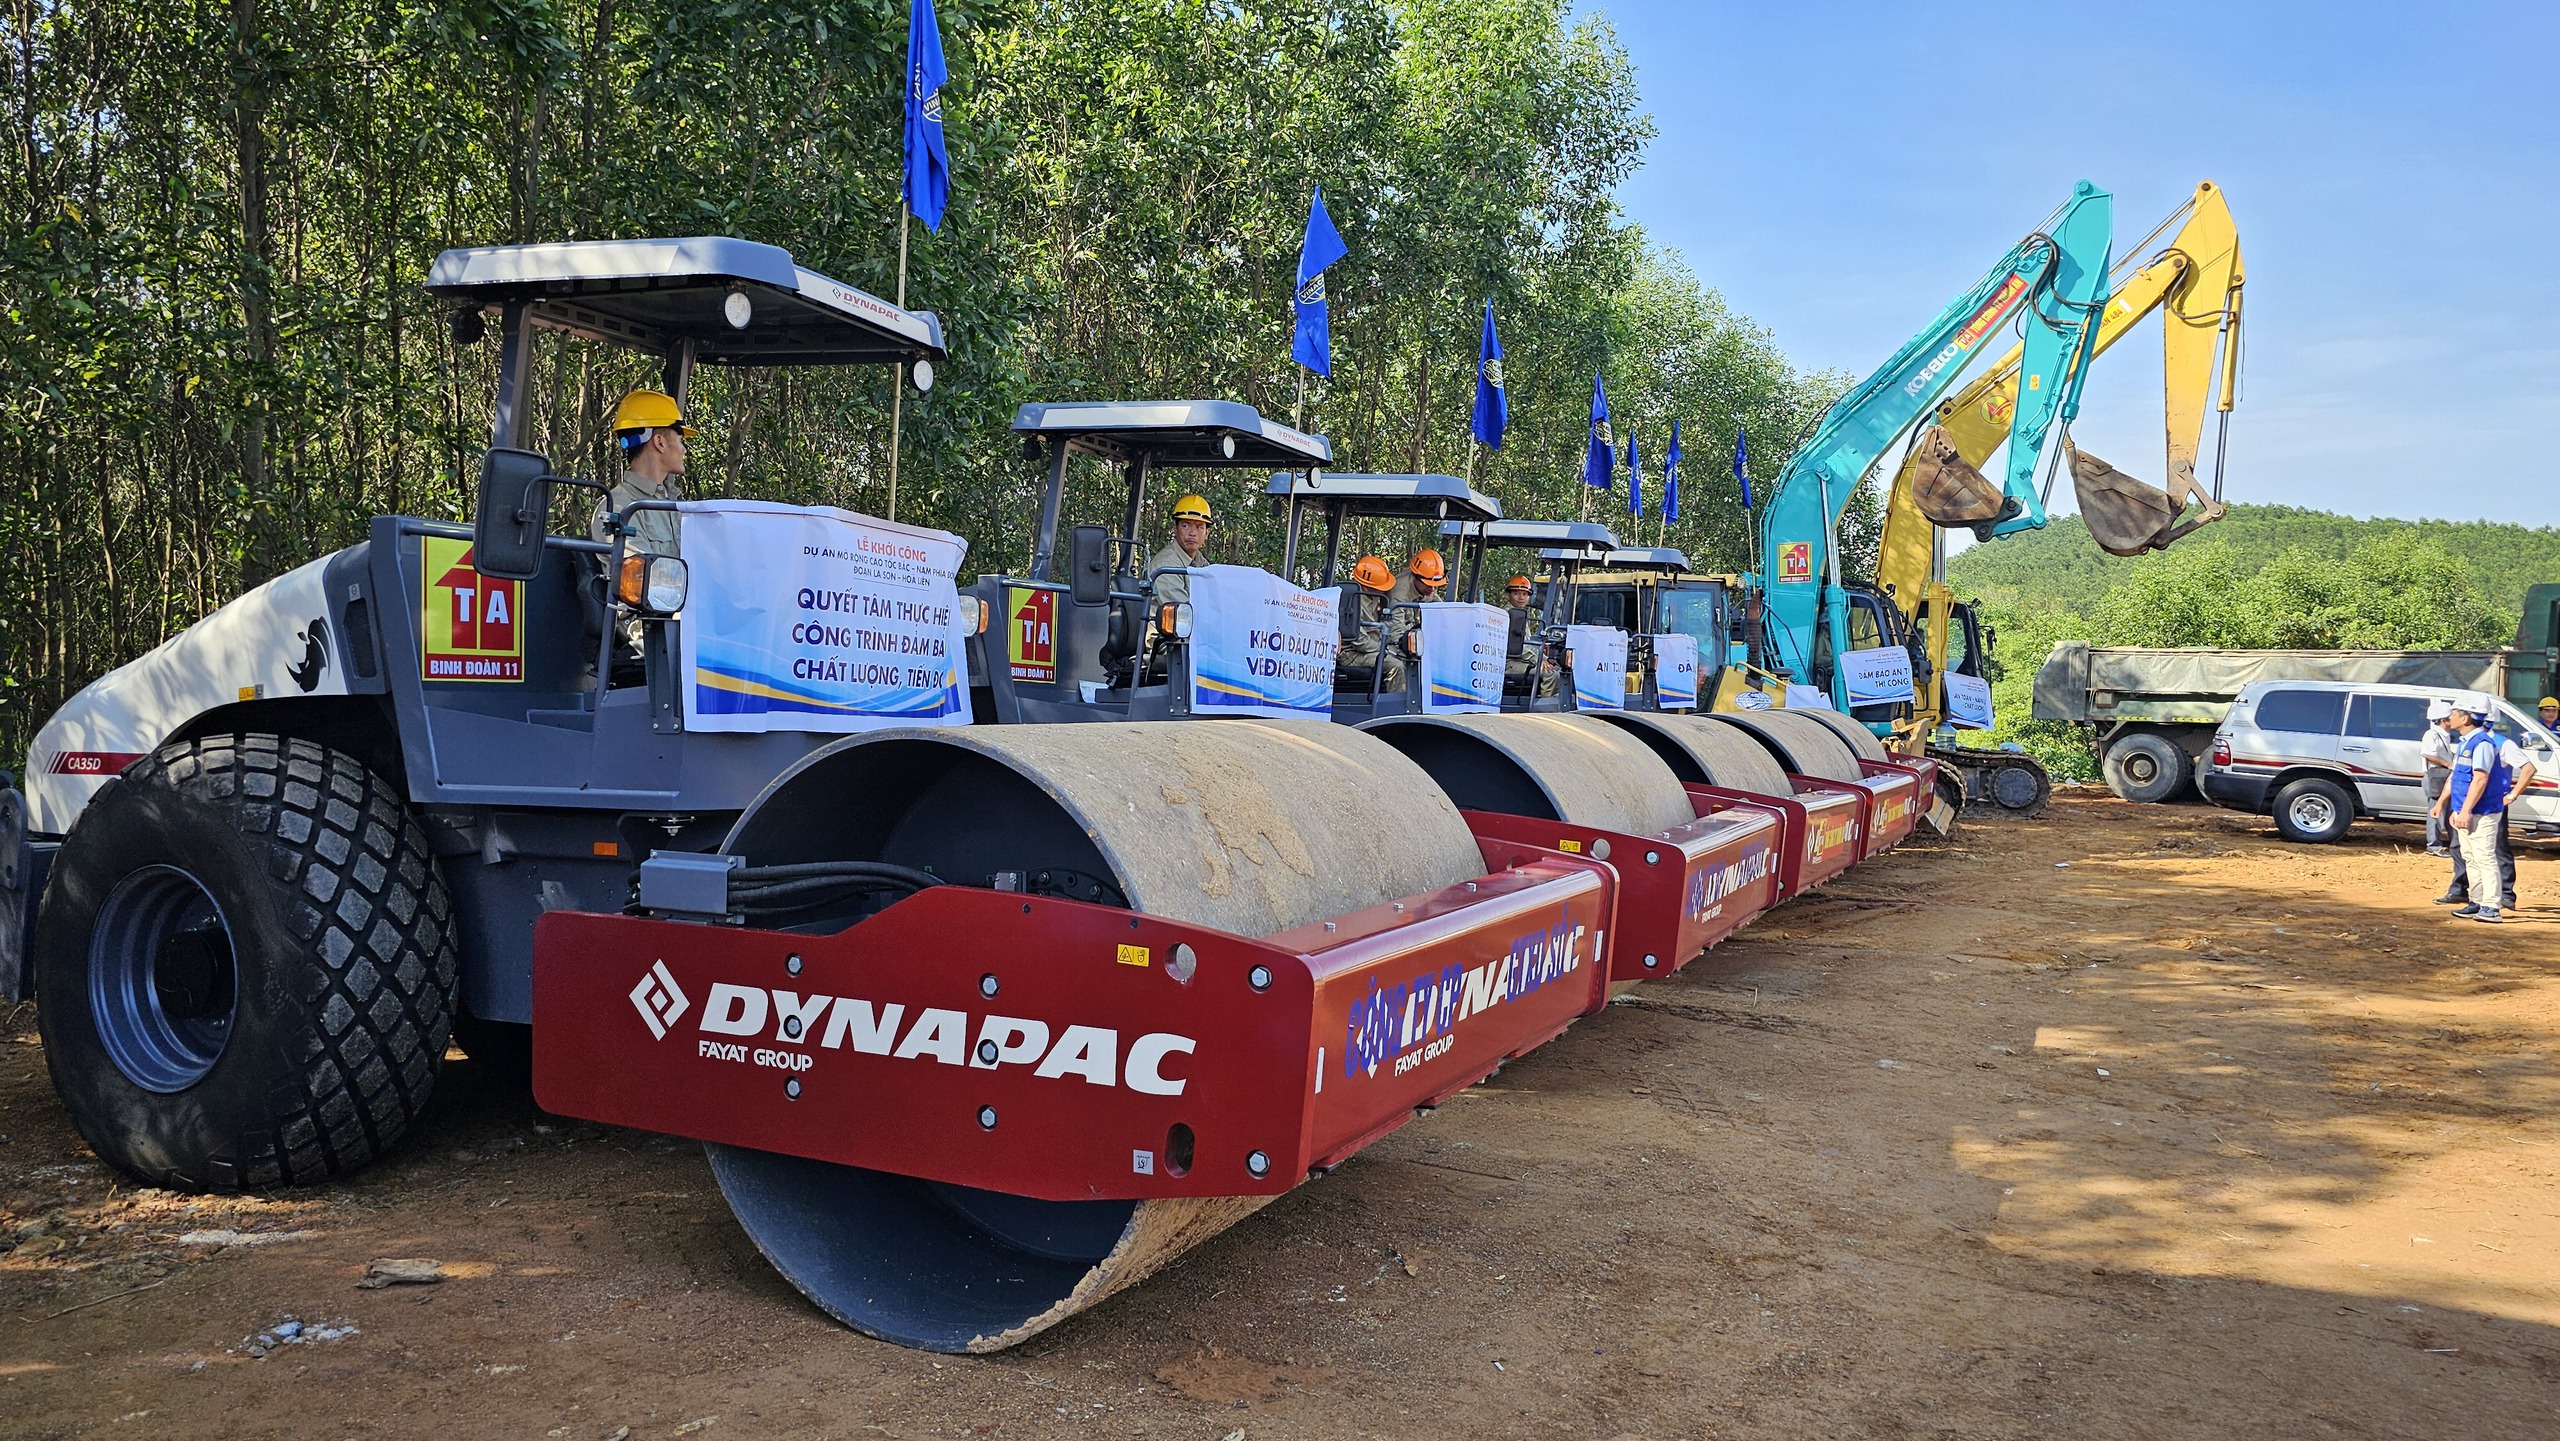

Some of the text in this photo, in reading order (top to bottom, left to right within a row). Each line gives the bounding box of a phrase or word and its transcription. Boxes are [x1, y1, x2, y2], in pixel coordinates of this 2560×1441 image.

[843, 292, 900, 323] DYNAPAC
[1903, 341, 1959, 398] KOBELCO
[803, 546, 819, 558] DỰ
[821, 545, 836, 558] ÁN
[869, 556, 883, 567] CAO
[916, 565, 932, 575] NAM
[857, 535, 926, 562] LỄ KHỞI CÔNG
[853, 565, 872, 578] ĐOẠN
[873, 568, 881, 579] LA
[1362, 569, 1372, 581] 11
[1413, 557, 1422, 569] 11
[797, 586, 858, 614] QUYẾT
[863, 593, 892, 619] TÂM
[897, 600, 930, 627] THỰC
[792, 619, 851, 648] CÔNG
[855, 626, 898, 653] TRÌNH
[901, 629, 929, 656] ĐẢM
[1250, 625, 1285, 652] KHỞI
[1288, 630, 1311, 657] ĐẦU
[1314, 635, 1329, 660] TỐT
[430, 658, 518, 676] BINH ĐOÀN 11
[793, 655, 848, 682] CHẤT
[850, 662, 902, 690] LƯỢNG,
[907, 663, 931, 689] TIẾN
[1011, 666, 1053, 679] BINH ĐOÀN 11
[1298, 659, 1326, 685] ĐÚNG
[1596, 662, 1609, 673] AN
[1678, 659, 1693, 673] ĐẢ
[1892, 668, 1903, 677] AN
[1875, 680, 1886, 689] THI
[67, 757, 102, 771] CA35D
[699, 982, 1197, 1096] DYNAPAC
[698, 1039, 814, 1072] FAYAT GROUP
[1394, 1033, 1454, 1077] FAYAT GROUP
